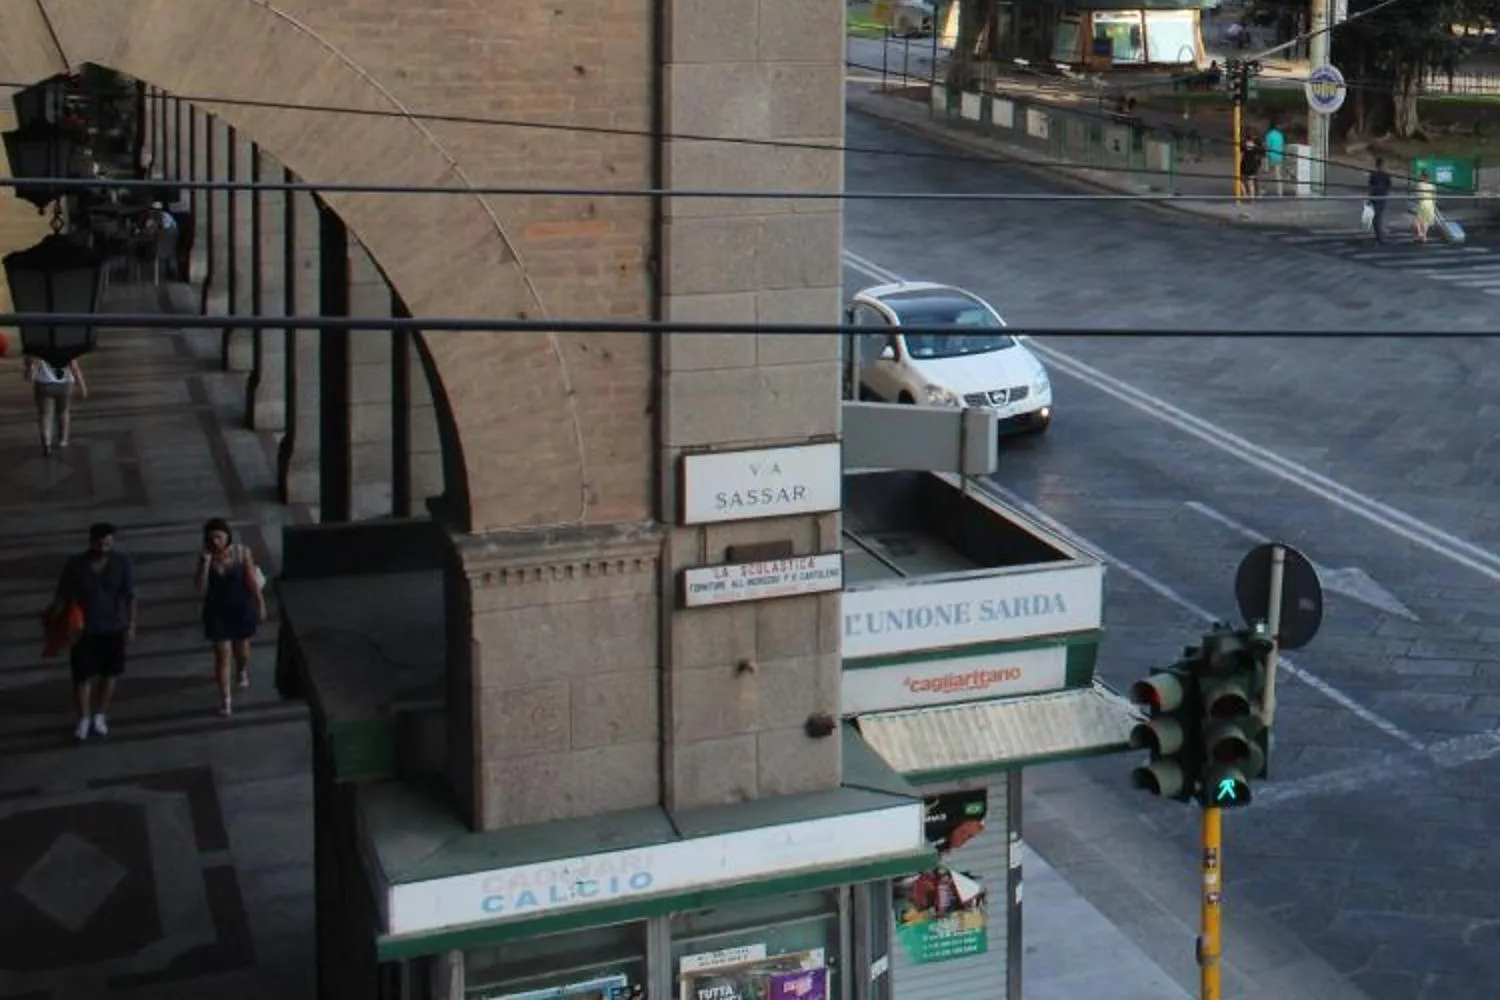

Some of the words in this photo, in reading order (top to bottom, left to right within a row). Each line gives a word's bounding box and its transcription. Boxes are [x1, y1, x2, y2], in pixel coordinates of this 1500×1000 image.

[749, 461, 782, 477] VA
[979, 592, 1067, 622] SARDA
[480, 871, 654, 913] CALCIO
